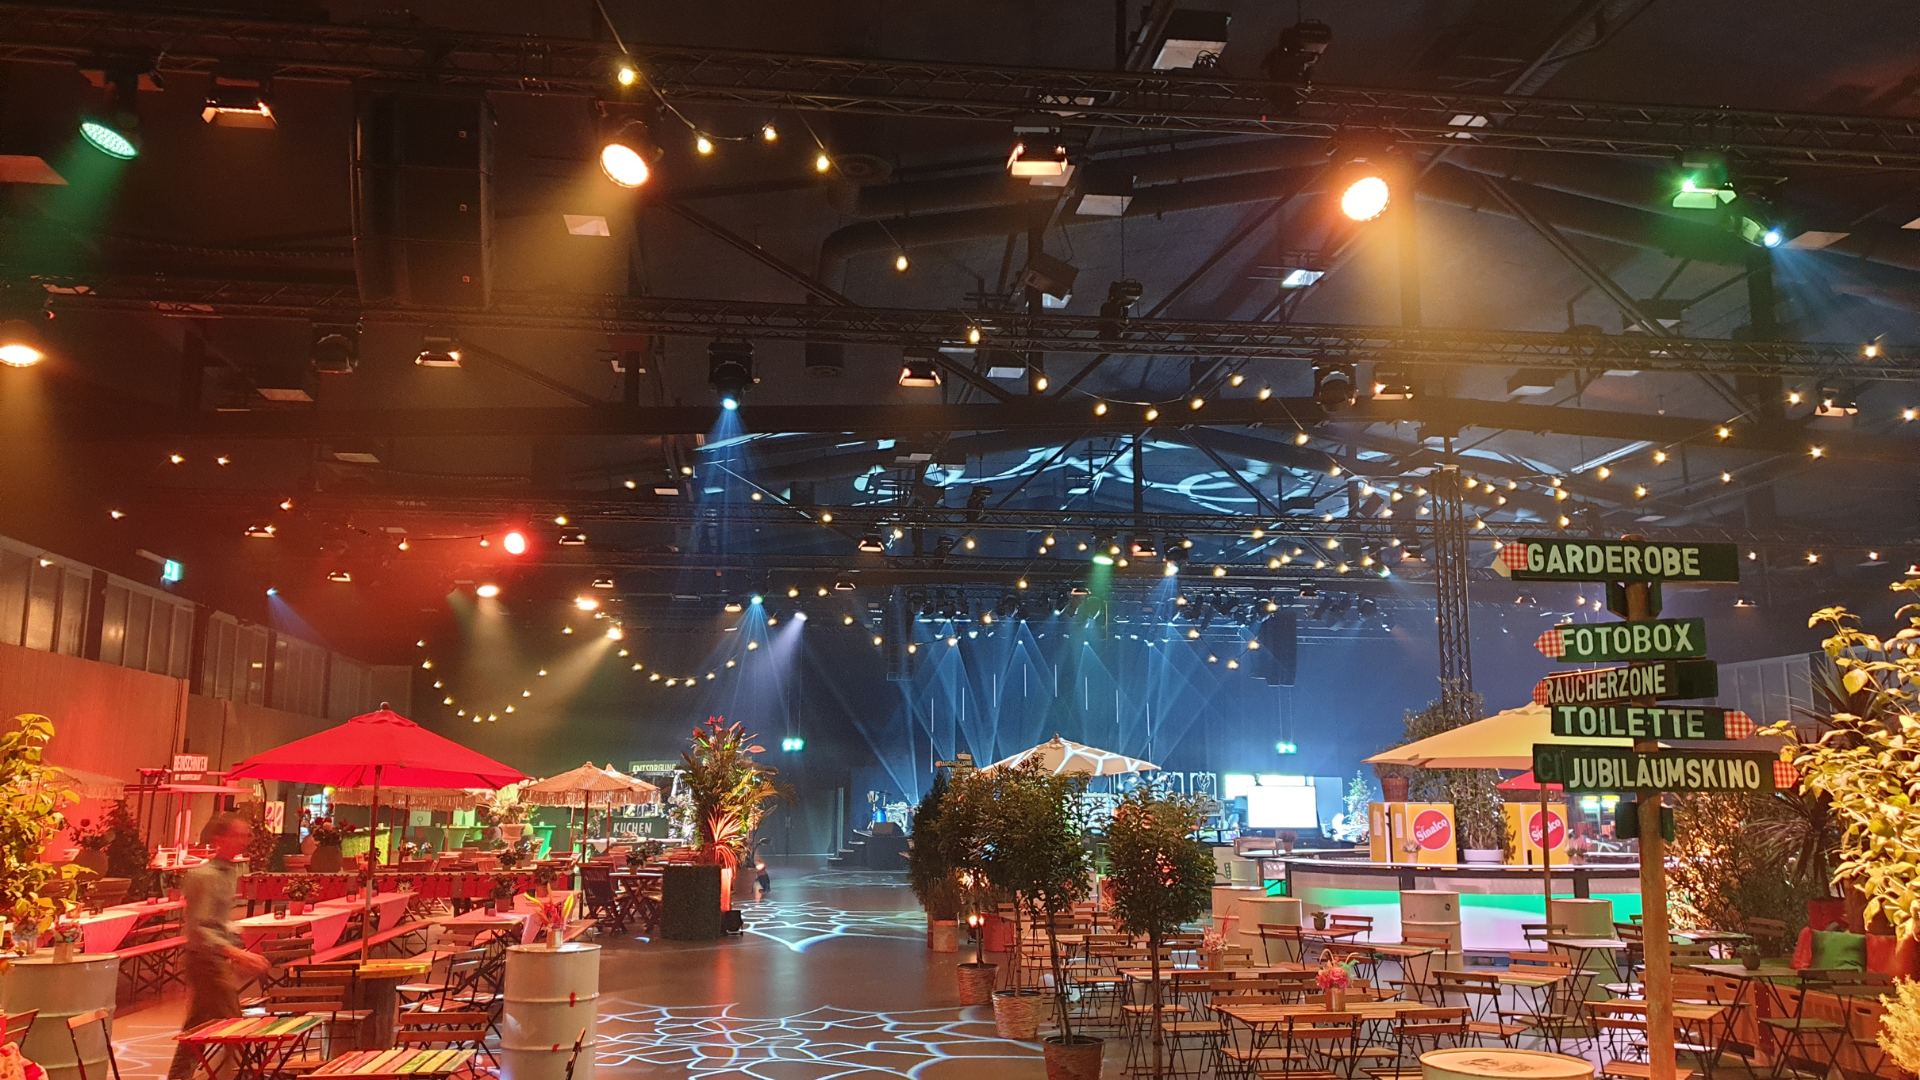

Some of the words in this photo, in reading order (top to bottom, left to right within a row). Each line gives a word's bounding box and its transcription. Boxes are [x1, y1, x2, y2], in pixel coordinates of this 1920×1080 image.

[1527, 543, 1701, 576] GARDEROBE
[1561, 623, 1694, 655] FOTOBOX
[1546, 664, 1666, 703] RAUCHERZONE
[1558, 706, 1705, 738] TOILETTE
[1569, 754, 1760, 788] JUBILÄUMSKINO
[613, 822, 653, 834] KUCHEN
[1415, 818, 1448, 842] Sinalco
